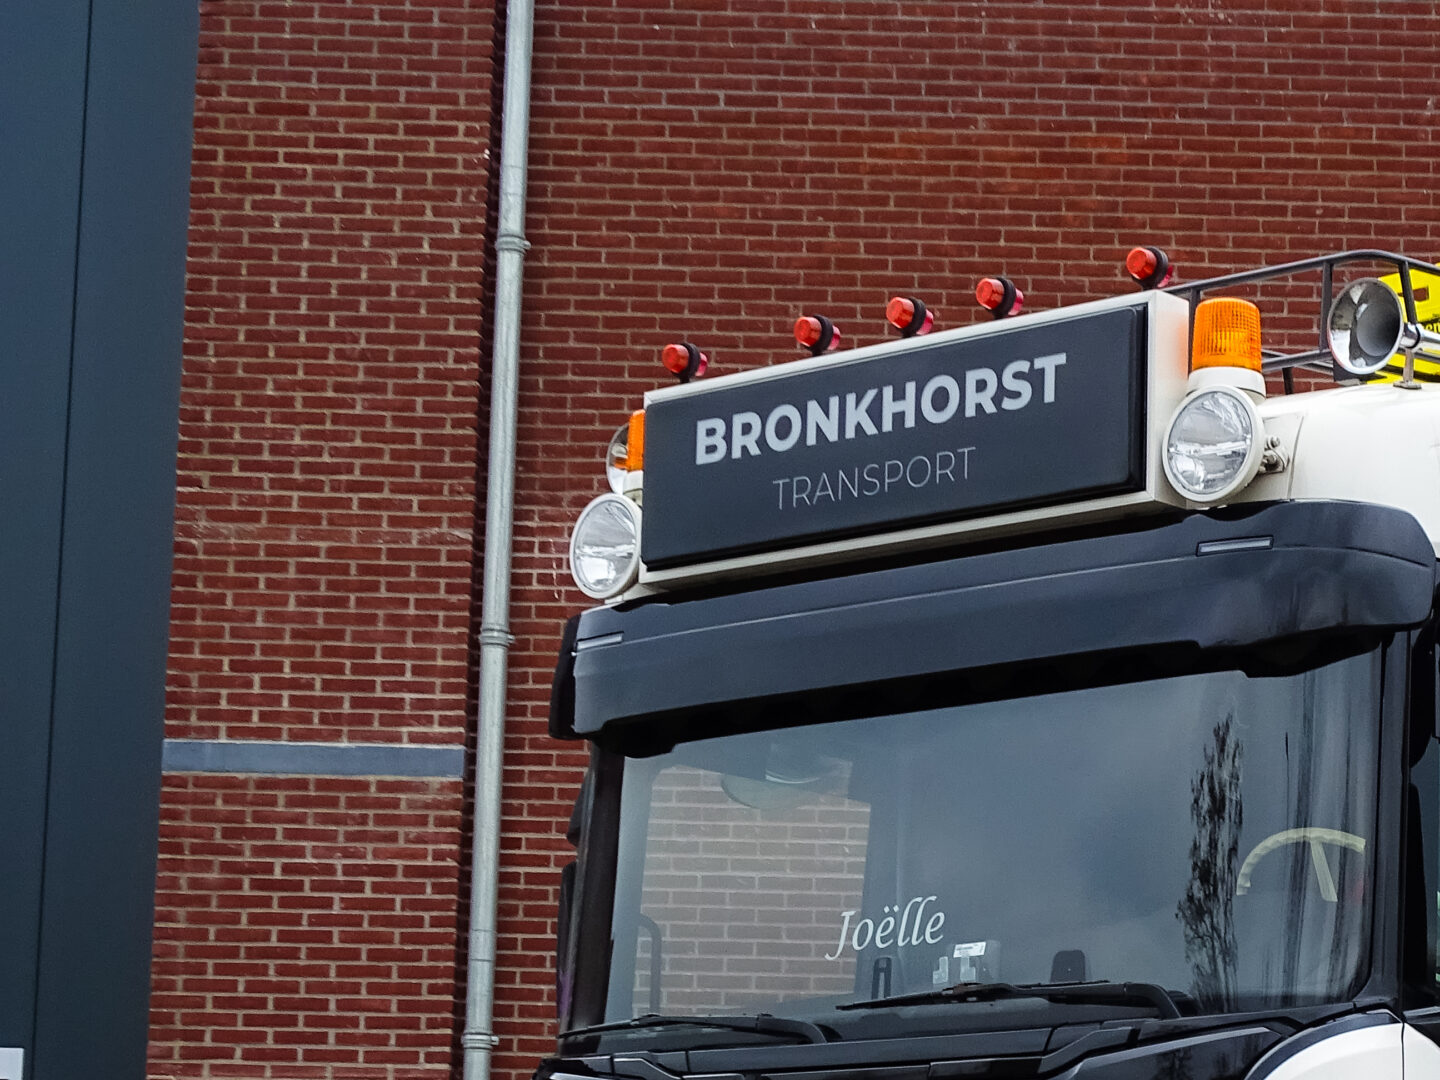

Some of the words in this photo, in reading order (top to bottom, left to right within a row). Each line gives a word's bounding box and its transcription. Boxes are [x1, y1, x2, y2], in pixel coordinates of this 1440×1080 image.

[694, 351, 1067, 466] BRONKHORST
[772, 446, 976, 511] TRANSPORT
[825, 895, 946, 962] Joëlle
